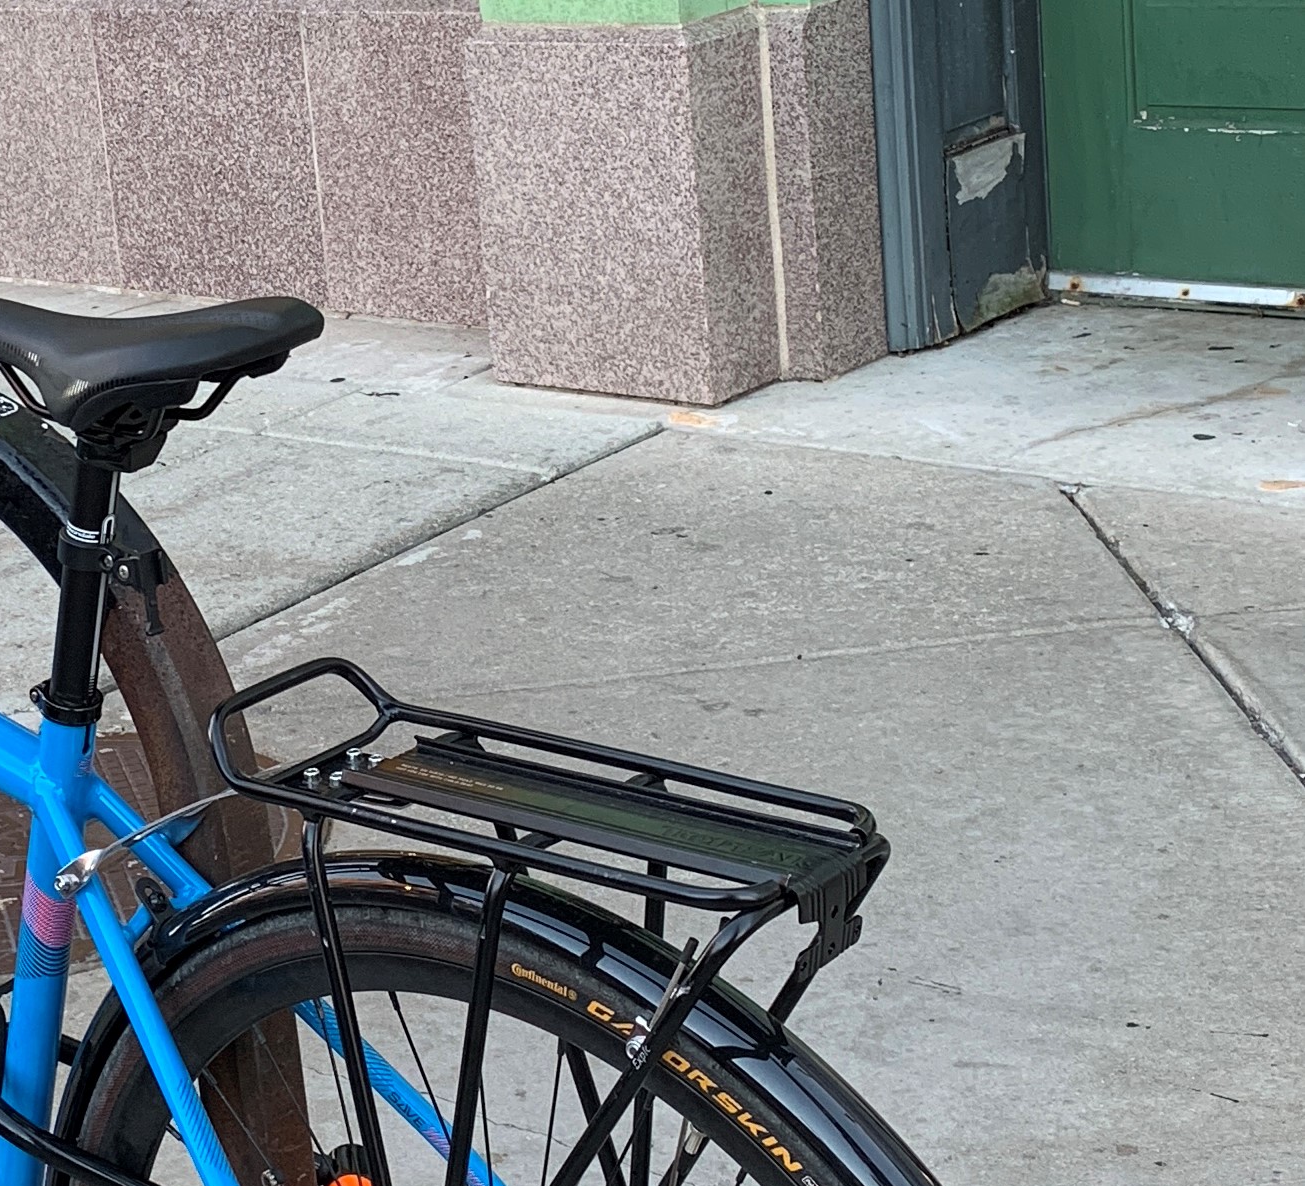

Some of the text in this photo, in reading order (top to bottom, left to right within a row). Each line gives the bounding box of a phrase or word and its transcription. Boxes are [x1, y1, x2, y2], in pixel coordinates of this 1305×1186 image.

[510, 962, 568, 998] Continental
[586, 999, 803, 1174] GAORSKIN
[387, 1091, 427, 1129] SAVE
